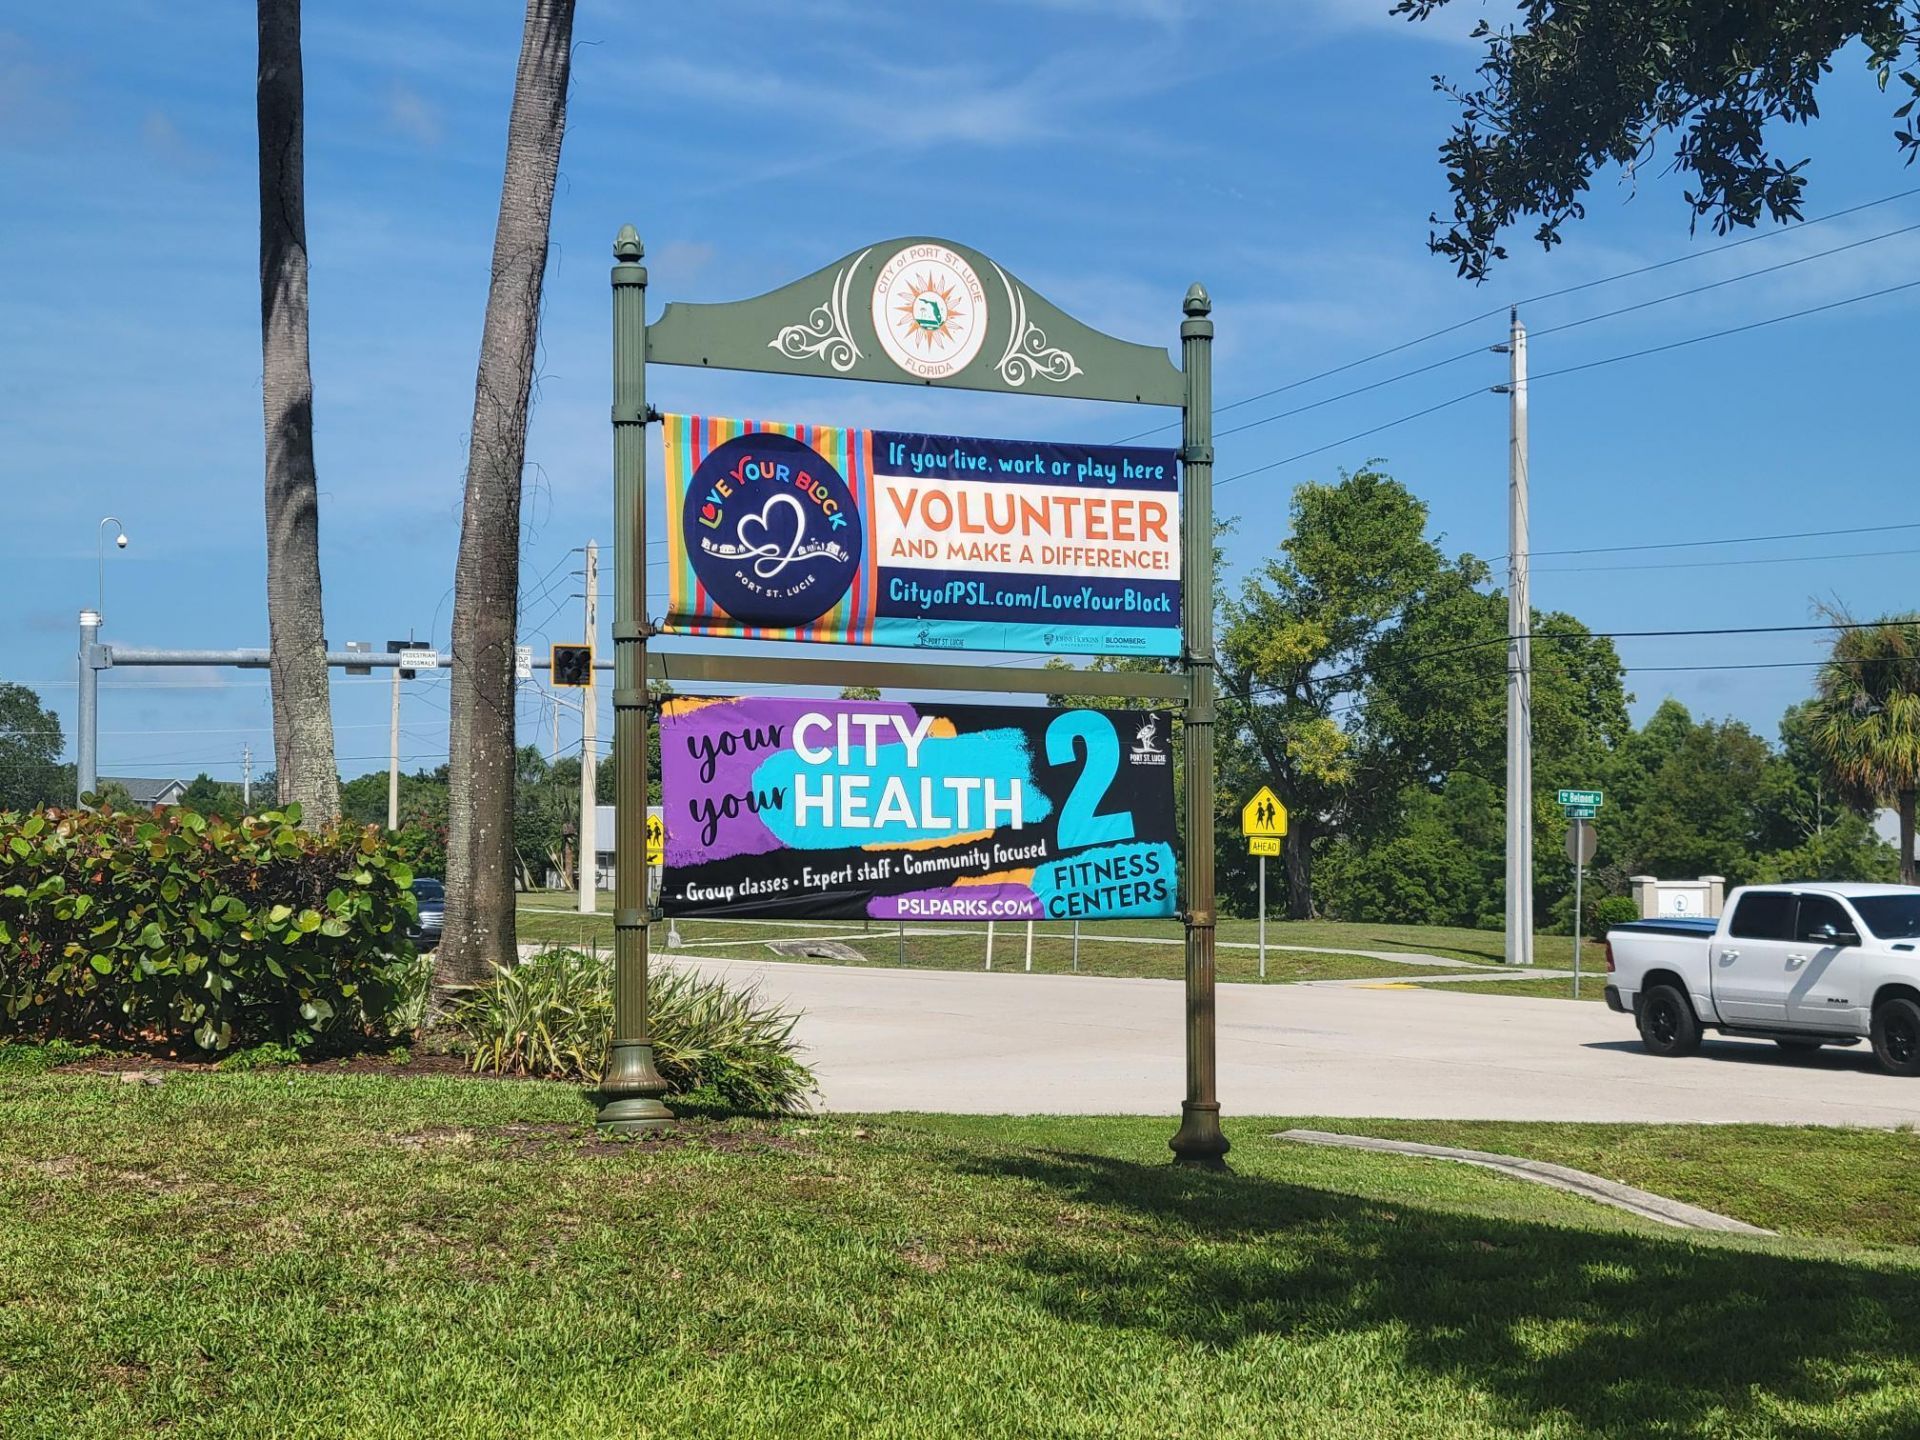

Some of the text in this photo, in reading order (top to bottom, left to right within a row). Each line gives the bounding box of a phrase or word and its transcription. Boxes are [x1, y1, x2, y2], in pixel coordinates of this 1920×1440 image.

[877, 247, 983, 304] CITY of PORT ST. LUCIE
[904, 359, 954, 375] FLORIDA
[889, 441, 1164, 484] If you live, work or play here
[729, 455, 790, 486] YOUR
[794, 470, 848, 531] BLOCK
[886, 486, 1169, 543] VOLUNTEER
[891, 537, 1170, 570] AND MAKE A DIFFERENCE!
[734, 570, 817, 598] PORT ST. LUCIE
[888, 577, 1172, 614] CityofPSL.com/LoveYourBlock
[1105, 636, 1146, 645] BLOOMBERG
[687, 712, 936, 784] your CITY
[1045, 709, 1135, 850] 2
[689, 774, 1024, 847] your HEALTH
[1252, 841, 1277, 852] AHEAD
[686, 838, 1047, 902] Group classes Expert staff Community focused
[1054, 851, 1160, 890] FITNESS
[897, 898, 1034, 916] PSLPARKS.COM
[1048, 878, 1168, 918] CENTERS
